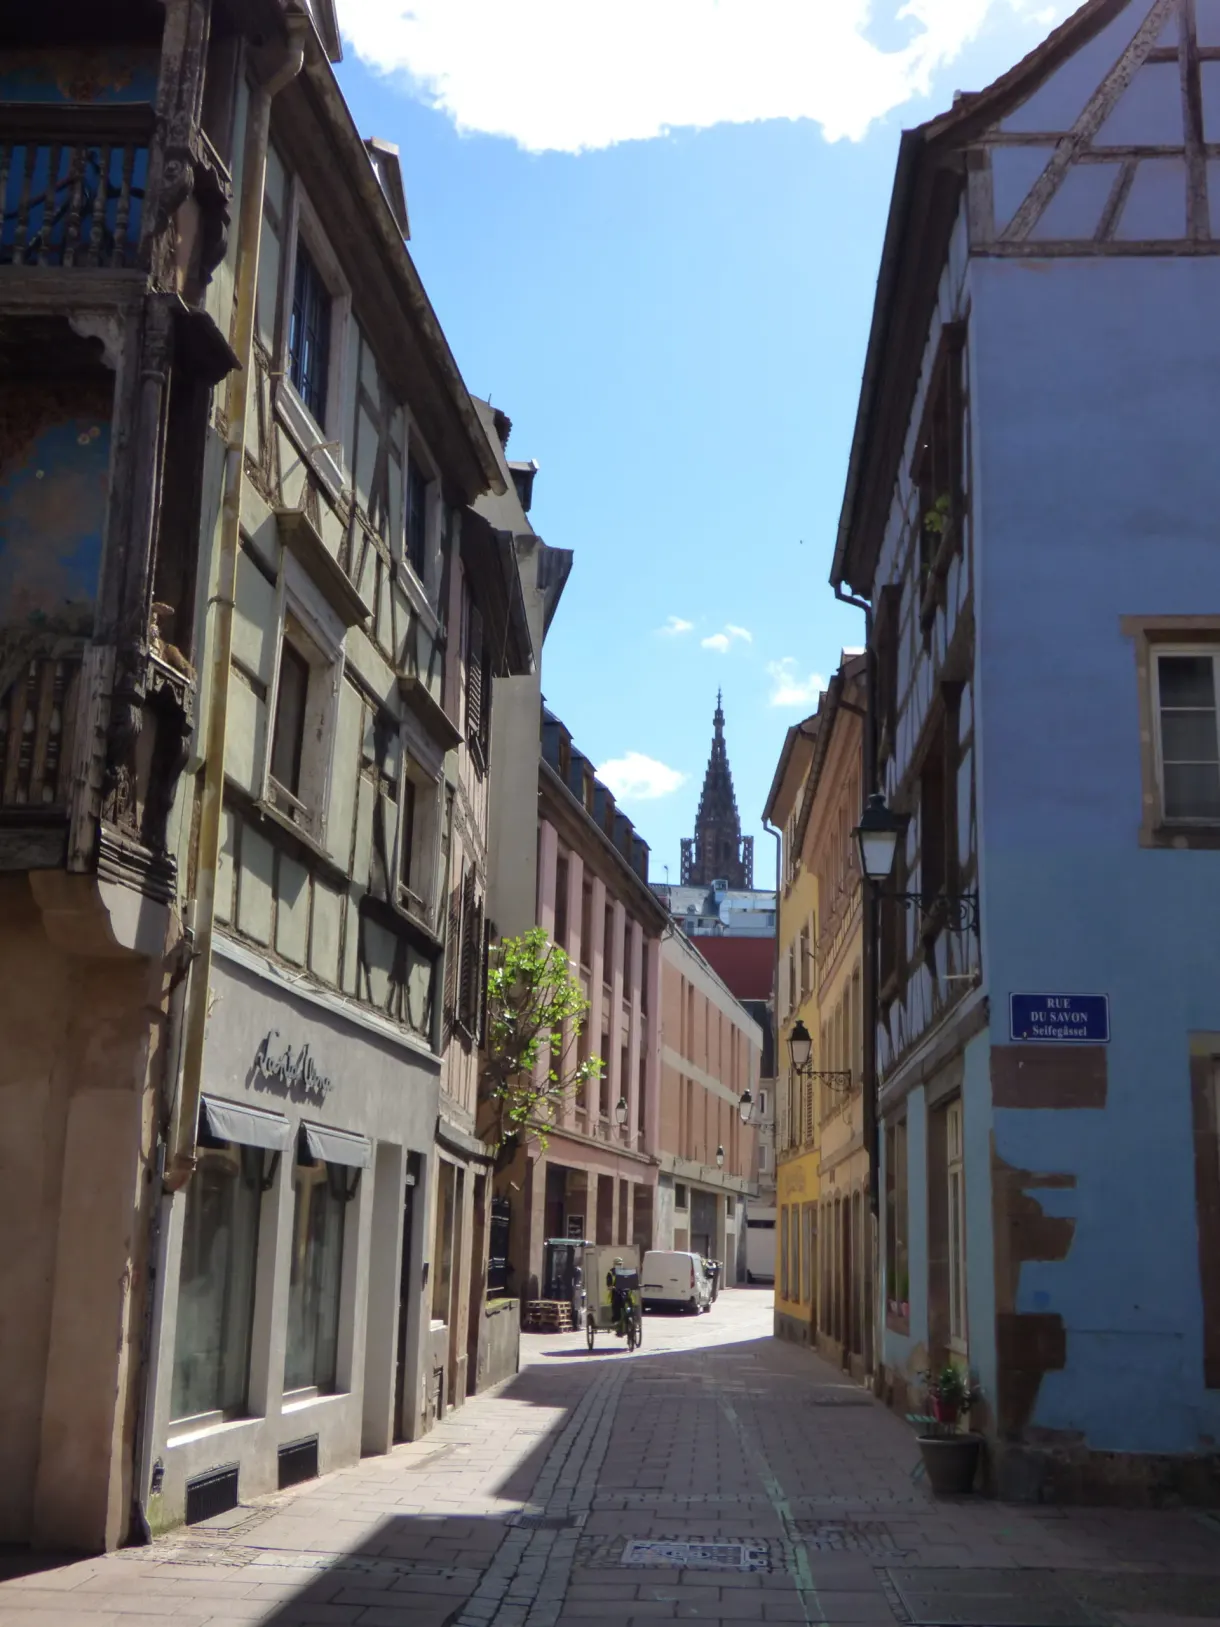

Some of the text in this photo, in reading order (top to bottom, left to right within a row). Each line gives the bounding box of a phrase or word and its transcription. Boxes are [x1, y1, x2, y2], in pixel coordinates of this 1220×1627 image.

[1047, 998, 1071, 1009] RUE
[1031, 1011, 1088, 1022] DU SAVON
